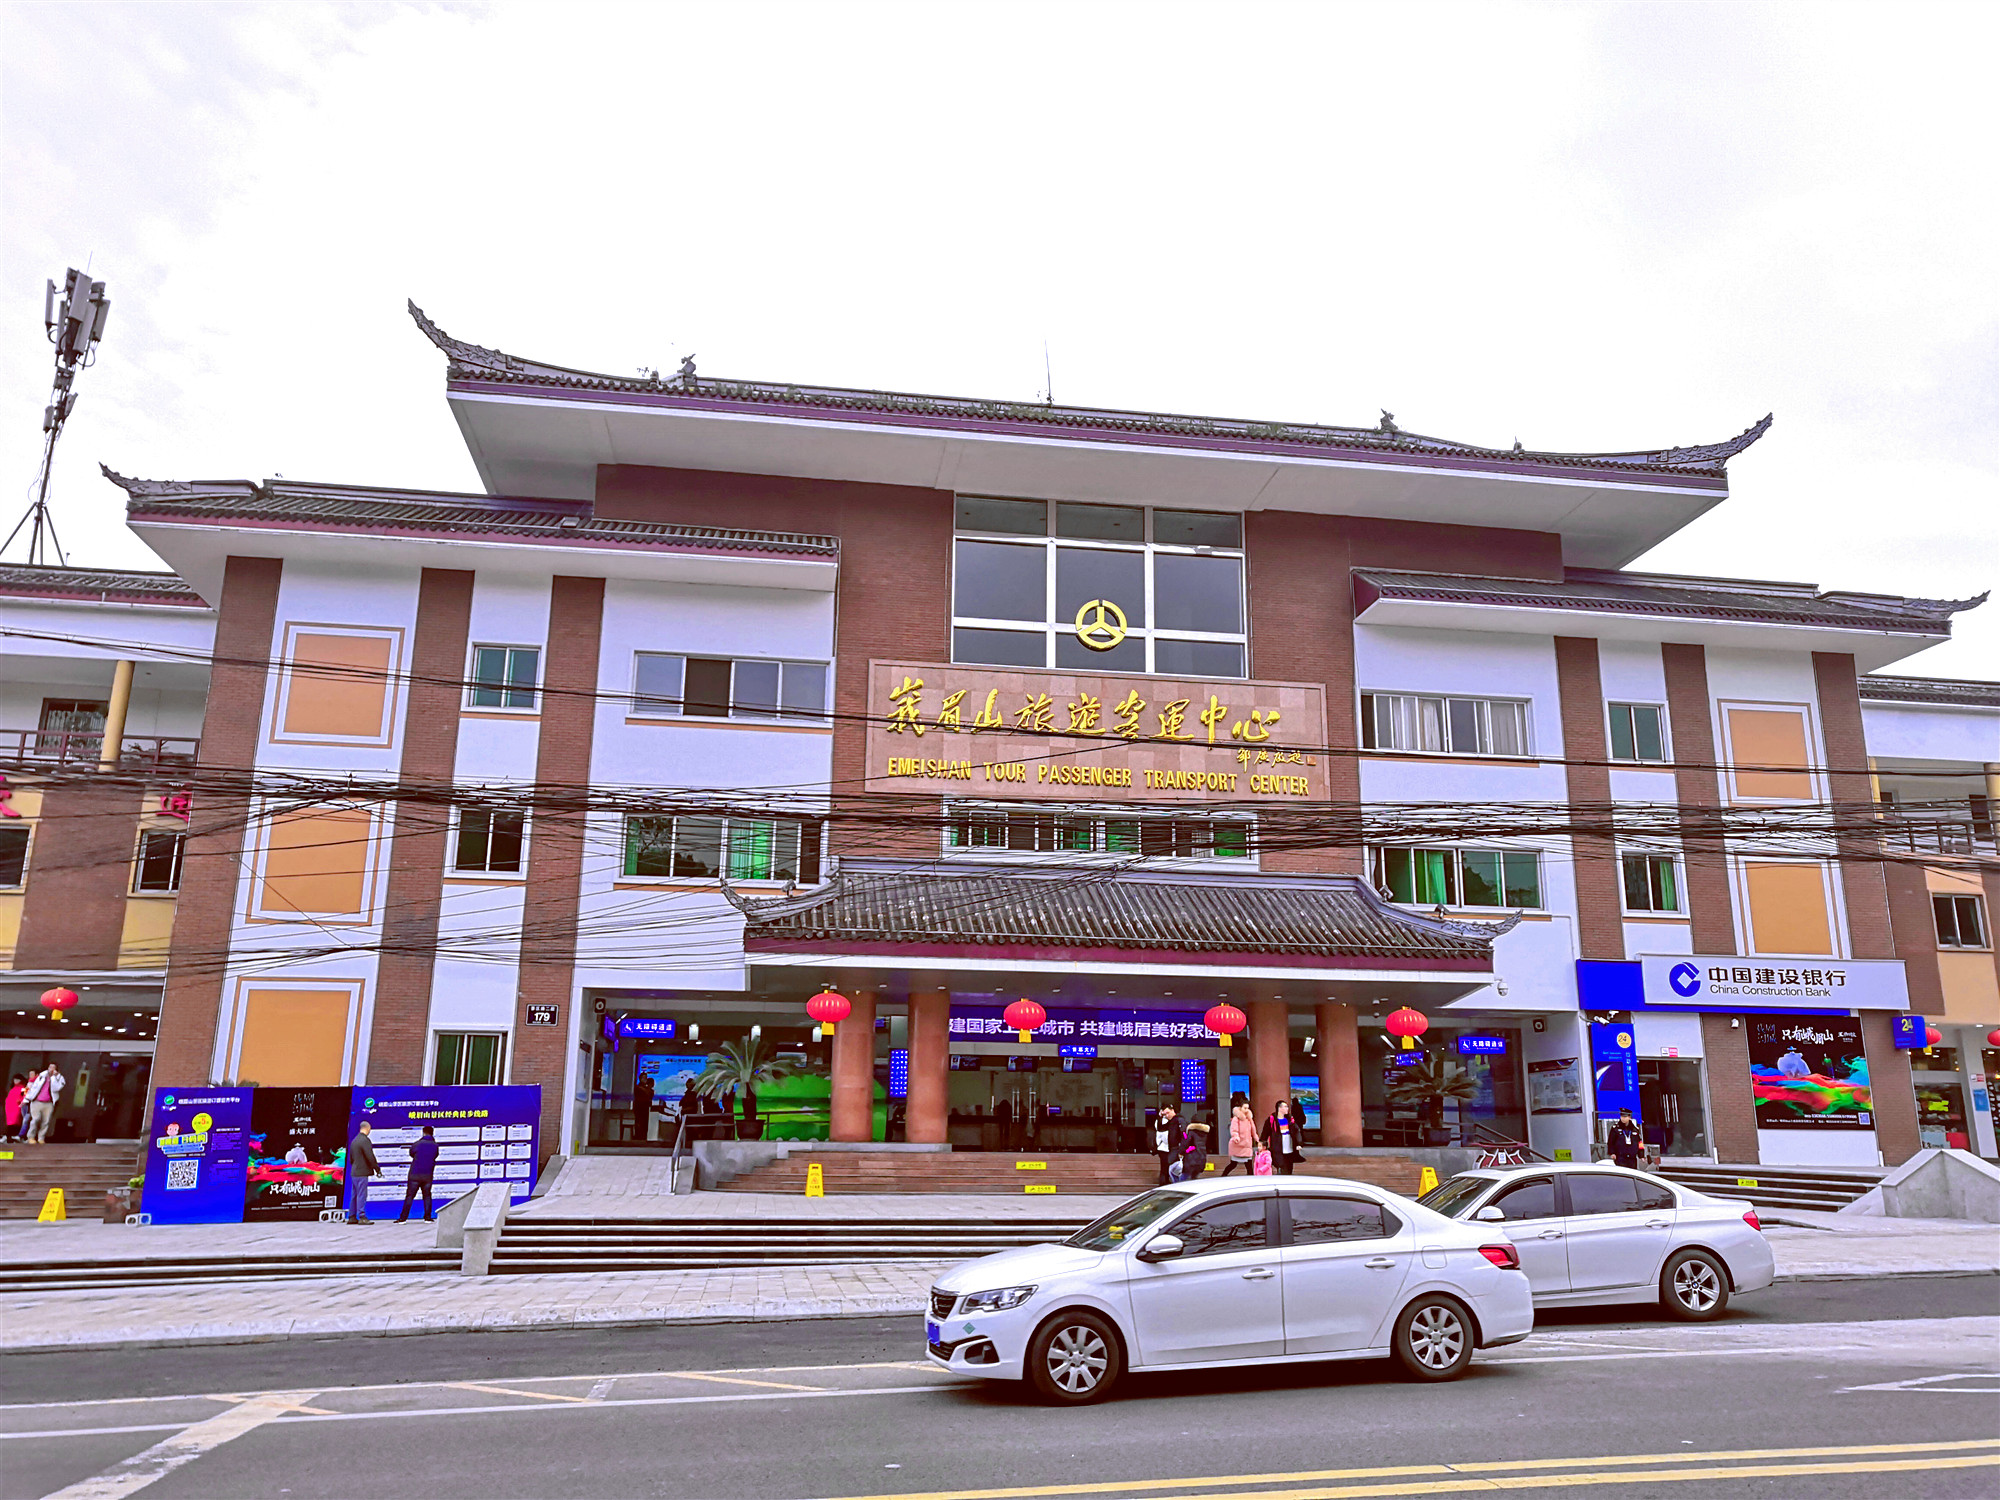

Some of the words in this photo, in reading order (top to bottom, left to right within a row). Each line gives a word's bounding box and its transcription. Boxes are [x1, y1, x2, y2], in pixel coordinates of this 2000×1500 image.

[887, 757, 971, 780] EMEISHAN
[983, 762, 1026, 783] TOUR
[1038, 765, 1132, 788] PASSENGER
[1144, 769, 1238, 793] TRANSPORT
[1250, 774, 1309, 796] CENTER
[1708, 966, 1846, 987] 中国建设银行
[1710, 984, 1739, 995] China
[1742, 985, 1803, 996] Construction
[1805, 987, 1831, 998] Bank
[534, 1012, 550, 1022] 179
[1901, 1018, 1914, 1031] 24
[948, 1018, 1075, 1036] 建国家城市
